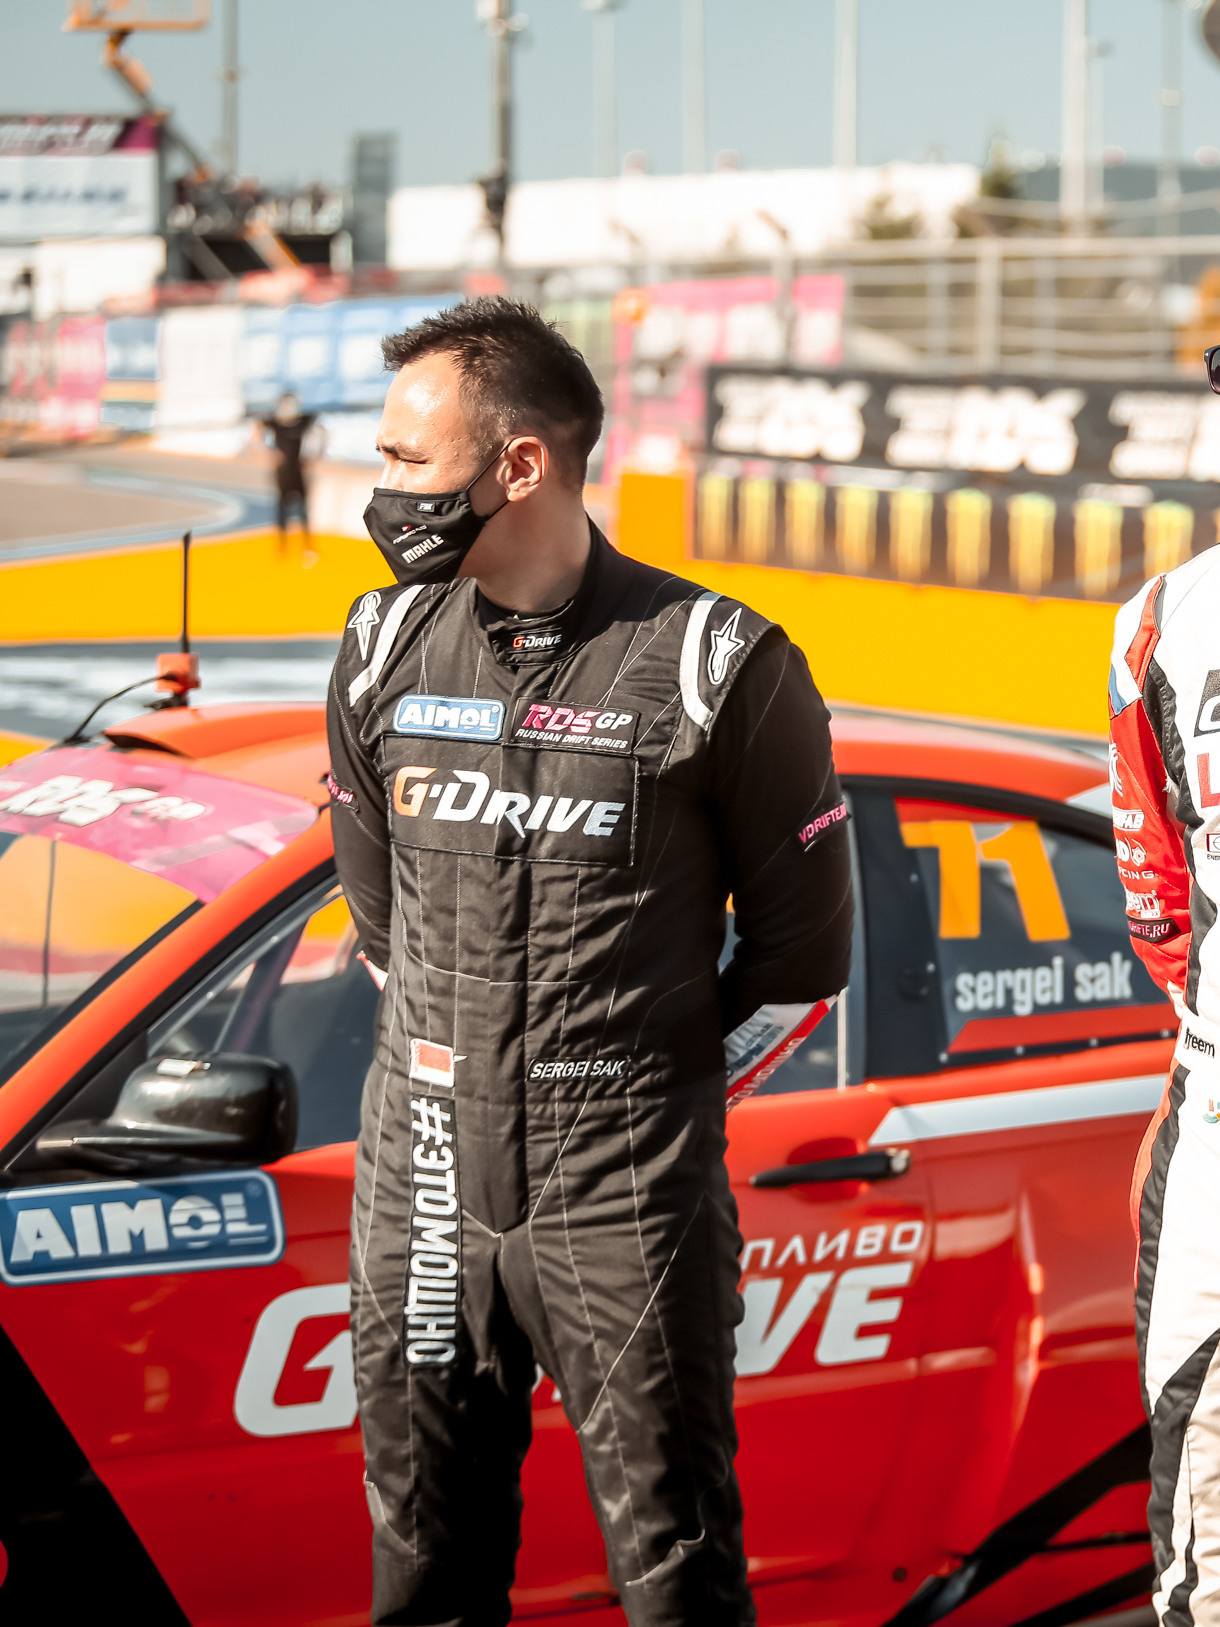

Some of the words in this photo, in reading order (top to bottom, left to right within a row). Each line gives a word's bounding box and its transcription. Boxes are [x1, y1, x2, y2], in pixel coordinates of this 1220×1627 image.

[401, 534, 445, 564] MAHLE
[397, 702, 497, 731] AIMOL
[522, 703, 602, 734] RDS
[595, 712, 634, 731] GP
[515, 729, 562, 743] RUSSIAN
[562, 733, 591, 746] DRIFT
[591, 736, 629, 750] SERIES
[955, 955, 1064, 1016] sergei
[1074, 951, 1133, 1003] sak
[530, 1060, 590, 1079] SERGEI
[592, 1060, 625, 1077] SAK
[10, 1192, 268, 1263] AIMOL
[404, 1097, 459, 1365] #ЭТОМОЩНО
[741, 1220, 924, 1272] ПЛИВО
[733, 1261, 914, 1378] VE
